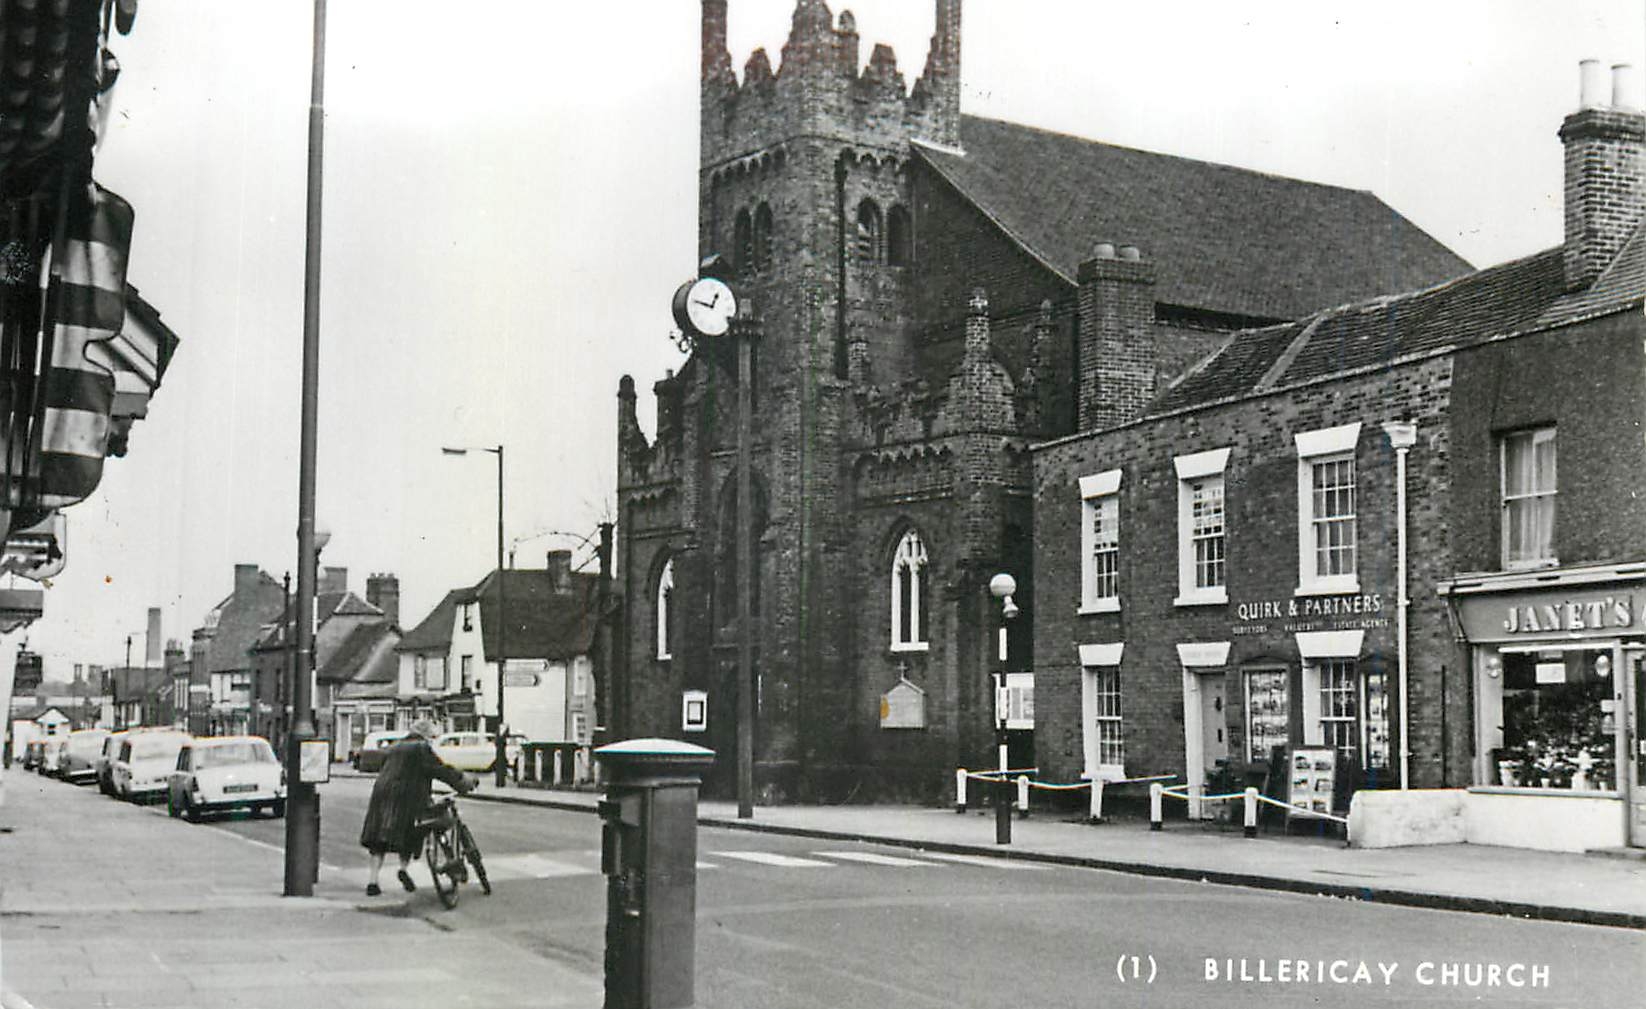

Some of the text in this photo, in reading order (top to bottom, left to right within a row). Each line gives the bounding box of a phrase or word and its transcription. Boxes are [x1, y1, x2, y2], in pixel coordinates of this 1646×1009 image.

[1238, 594, 1381, 620] QUIRK & PARTNERS
[1504, 597, 1633, 633] JANET'S
